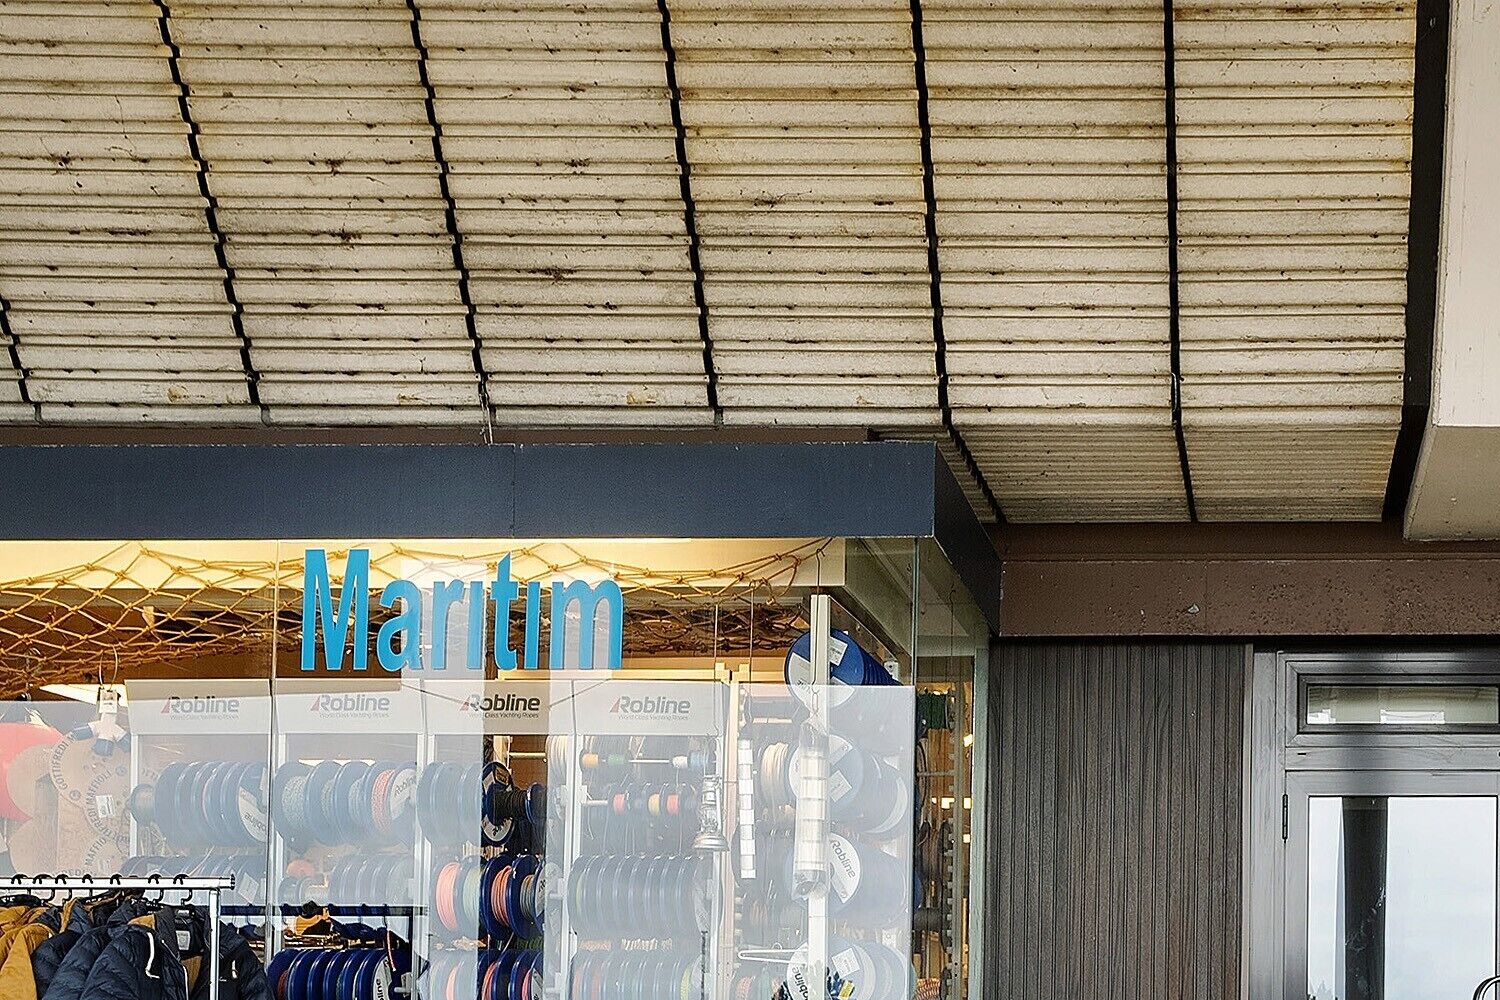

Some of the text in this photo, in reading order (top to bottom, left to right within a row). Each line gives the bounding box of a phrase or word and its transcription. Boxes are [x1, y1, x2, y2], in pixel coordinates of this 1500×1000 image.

[161, 696, 240, 713] Robline
[310, 694, 390, 711] Robline
[460, 694, 541, 711] Robline
[610, 696, 691, 713] Robline
[244, 811, 267, 832] obline
[829, 838, 857, 879] Robline
